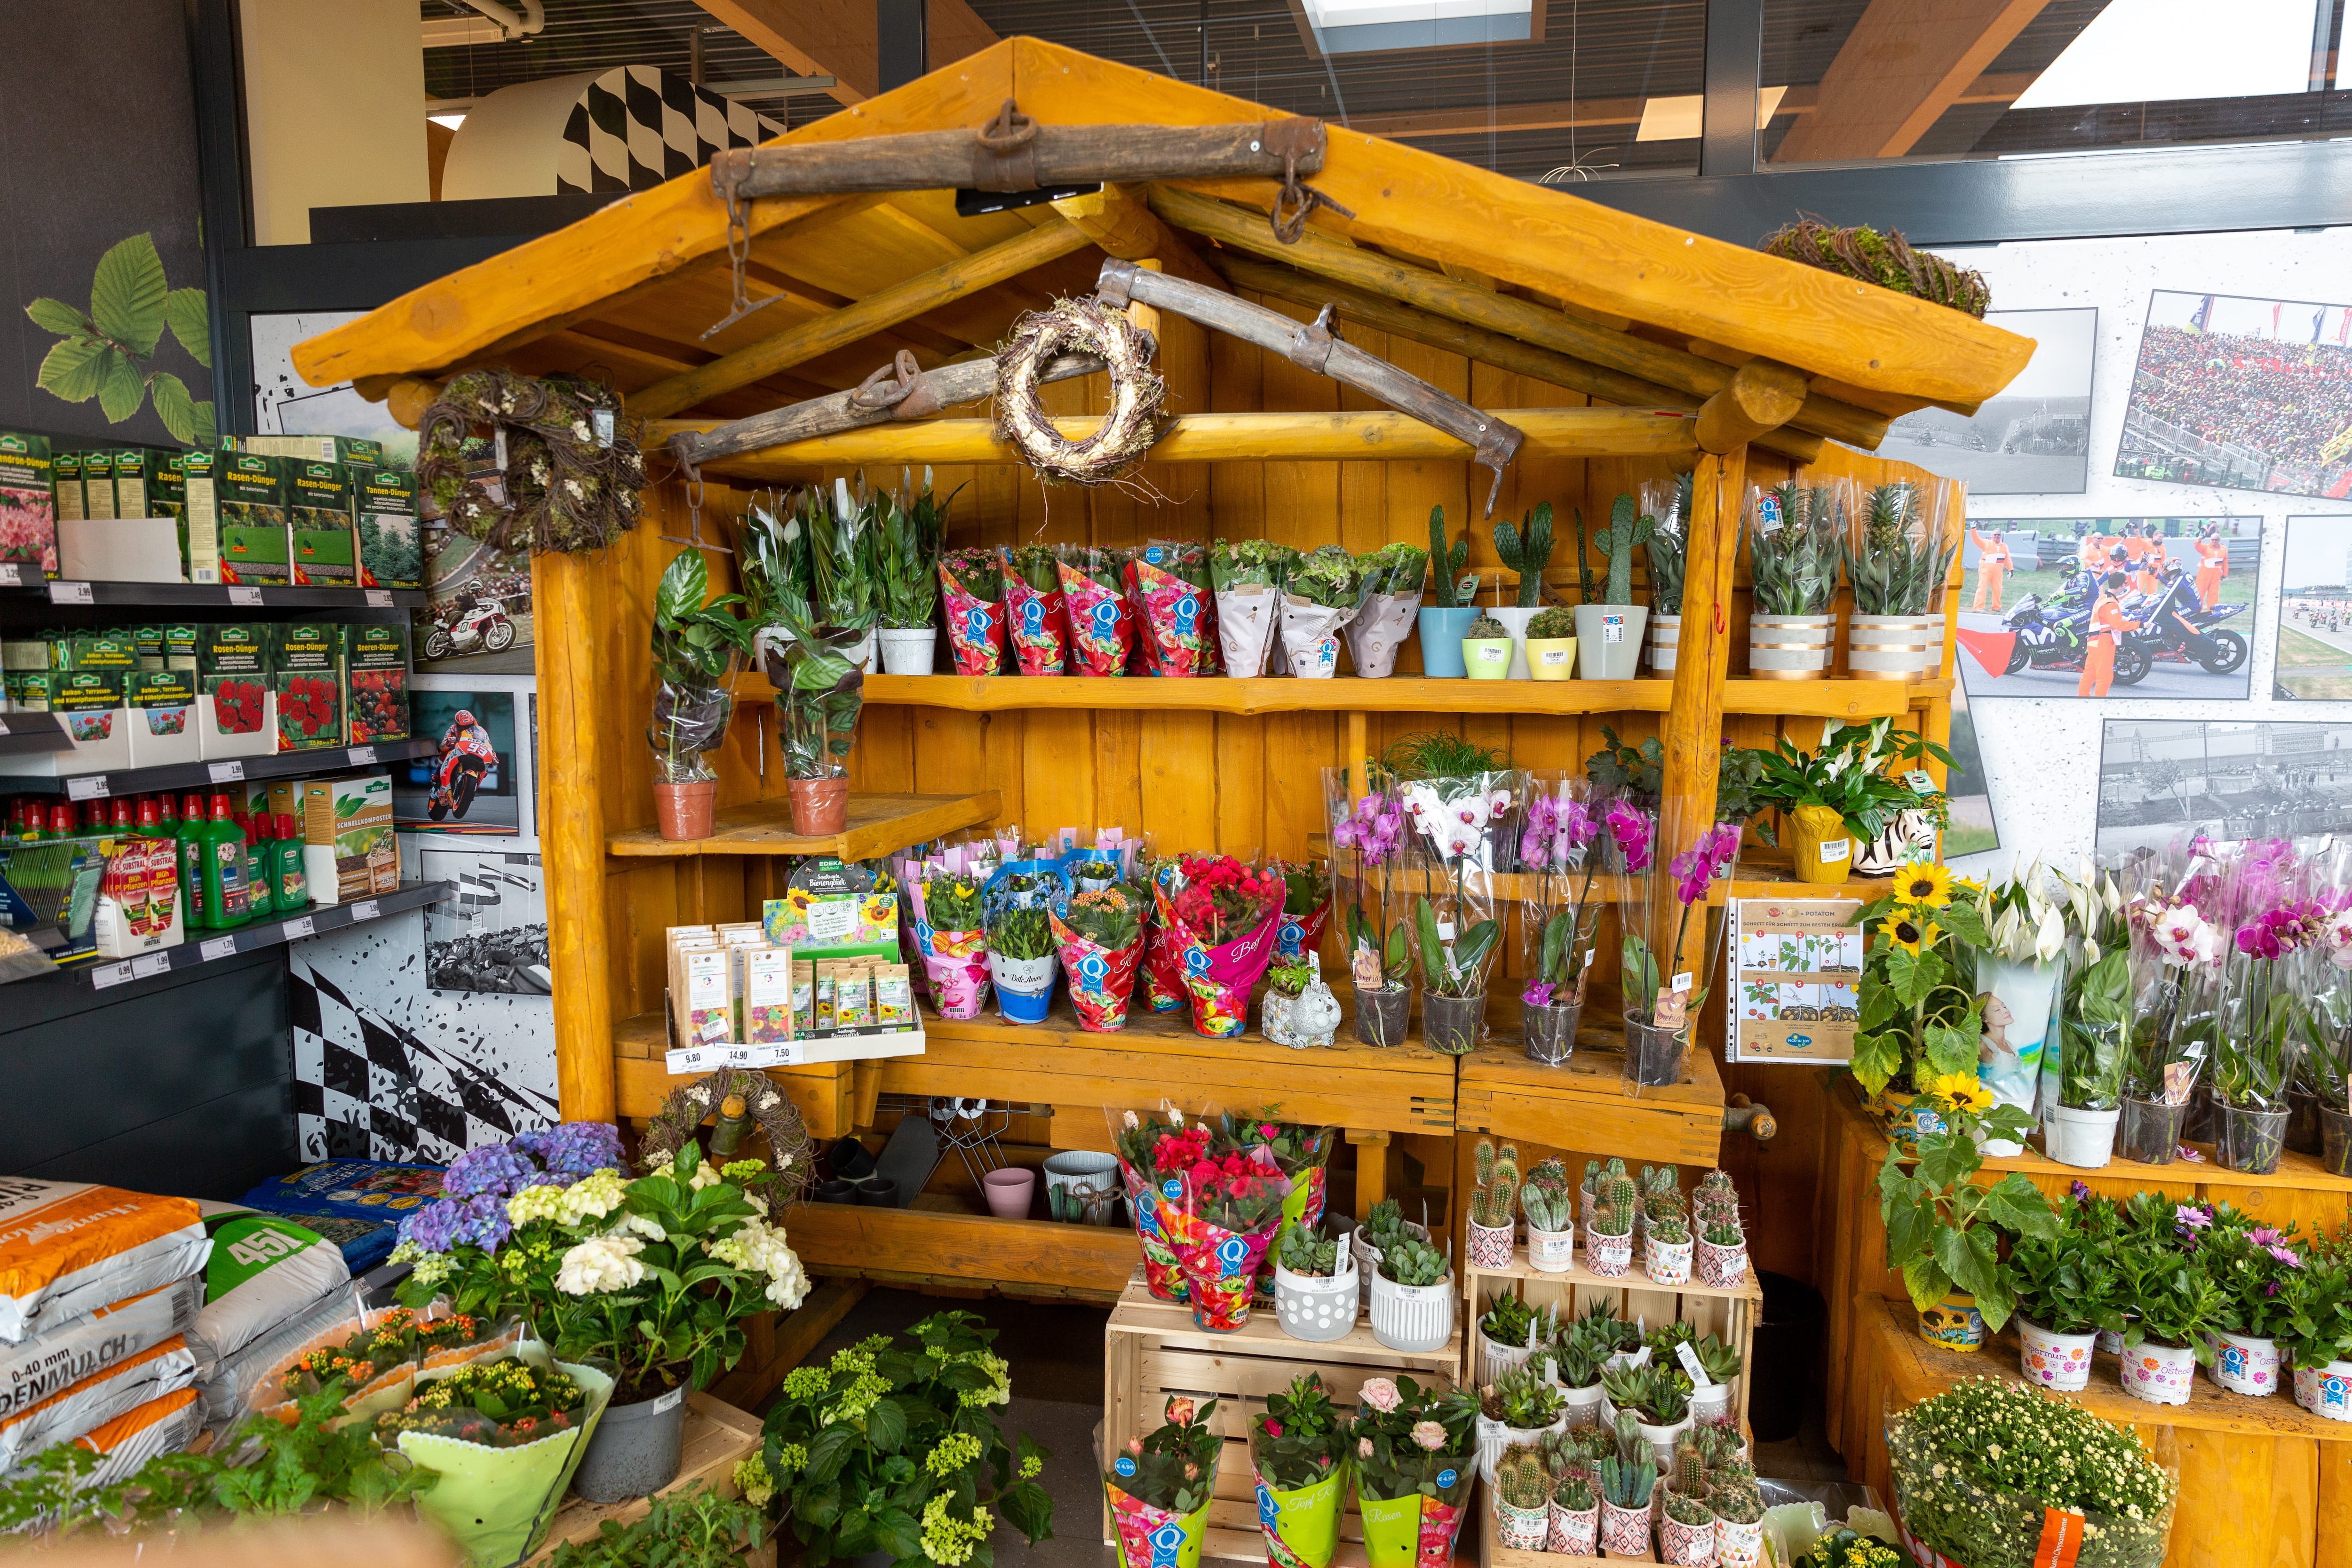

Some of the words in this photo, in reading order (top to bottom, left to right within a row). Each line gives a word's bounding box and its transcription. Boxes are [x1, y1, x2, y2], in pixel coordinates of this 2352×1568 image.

[347, 453, 374, 462] Tannen-Dünger
[227, 472, 277, 486] Rasen-Dünger
[297, 478, 342, 491] Rasen-Dünger
[366, 486, 411, 498] Tannen-Dünger
[1763, 501, 1774, 511] Q
[78, 587, 91, 596] 2.99
[1025, 602, 1041, 622] Q
[1178, 598, 1196, 619] Q
[1096, 604, 1116, 625] Q
[2071, 609, 2091, 620] YAMAHA
[971, 611, 987, 631] Q
[458, 623, 470, 632] 101
[213, 645, 259, 653] Rosen-Dünger
[286, 643, 328, 652] Rosen-Dünger
[358, 643, 399, 652] Beeren-Dünger
[1322, 643, 1332, 653] Q
[467, 742, 487, 757] 93
[337, 813, 391, 829] SCHNELLKOMPOSTER
[123, 860, 145, 871] SUBSTRAL
[151, 856, 174, 867] SUBSTRAL
[123, 882, 148, 891] Pflanzen
[151, 876, 175, 887] Pflanzen
[809, 878, 847, 887] Bienenglück
[302, 920, 311, 929] 3.99
[917, 921, 929, 942] Q
[1281, 926, 1300, 942] Q
[144, 938, 160, 947] SUBSTRAL
[223, 940, 233, 949] 1.79
[157, 956, 168, 965] 1.99
[1188, 950, 1207, 971] Q
[119, 967, 130, 975] 0.99
[1083, 957, 1104, 979] Q
[1657, 1013, 1682, 1022] Orchid
[686, 1053, 700, 1063] 9.80
[730, 1051, 747, 1059] 14.90
[775, 1049, 789, 1058] 7.50
[311, 1161, 358, 1185] TOMATEN-
[1141, 1220, 1157, 1229] QUALITÄT
[1223, 1242, 1244, 1262] Q
[2225, 1350, 2241, 1364] Q
[12, 1360, 40, 1383] 0-40
[45, 1348, 70, 1367] mm
[2327, 1380, 2344, 1394] Q
[1258, 1490, 1273, 1515] Q
[1287, 1497, 1314, 1511] Topf
[1369, 1509, 1401, 1522] Rosen
[1155, 1528, 1180, 1550] Q
[2053, 1517, 2068, 1556] Chrysantheme
